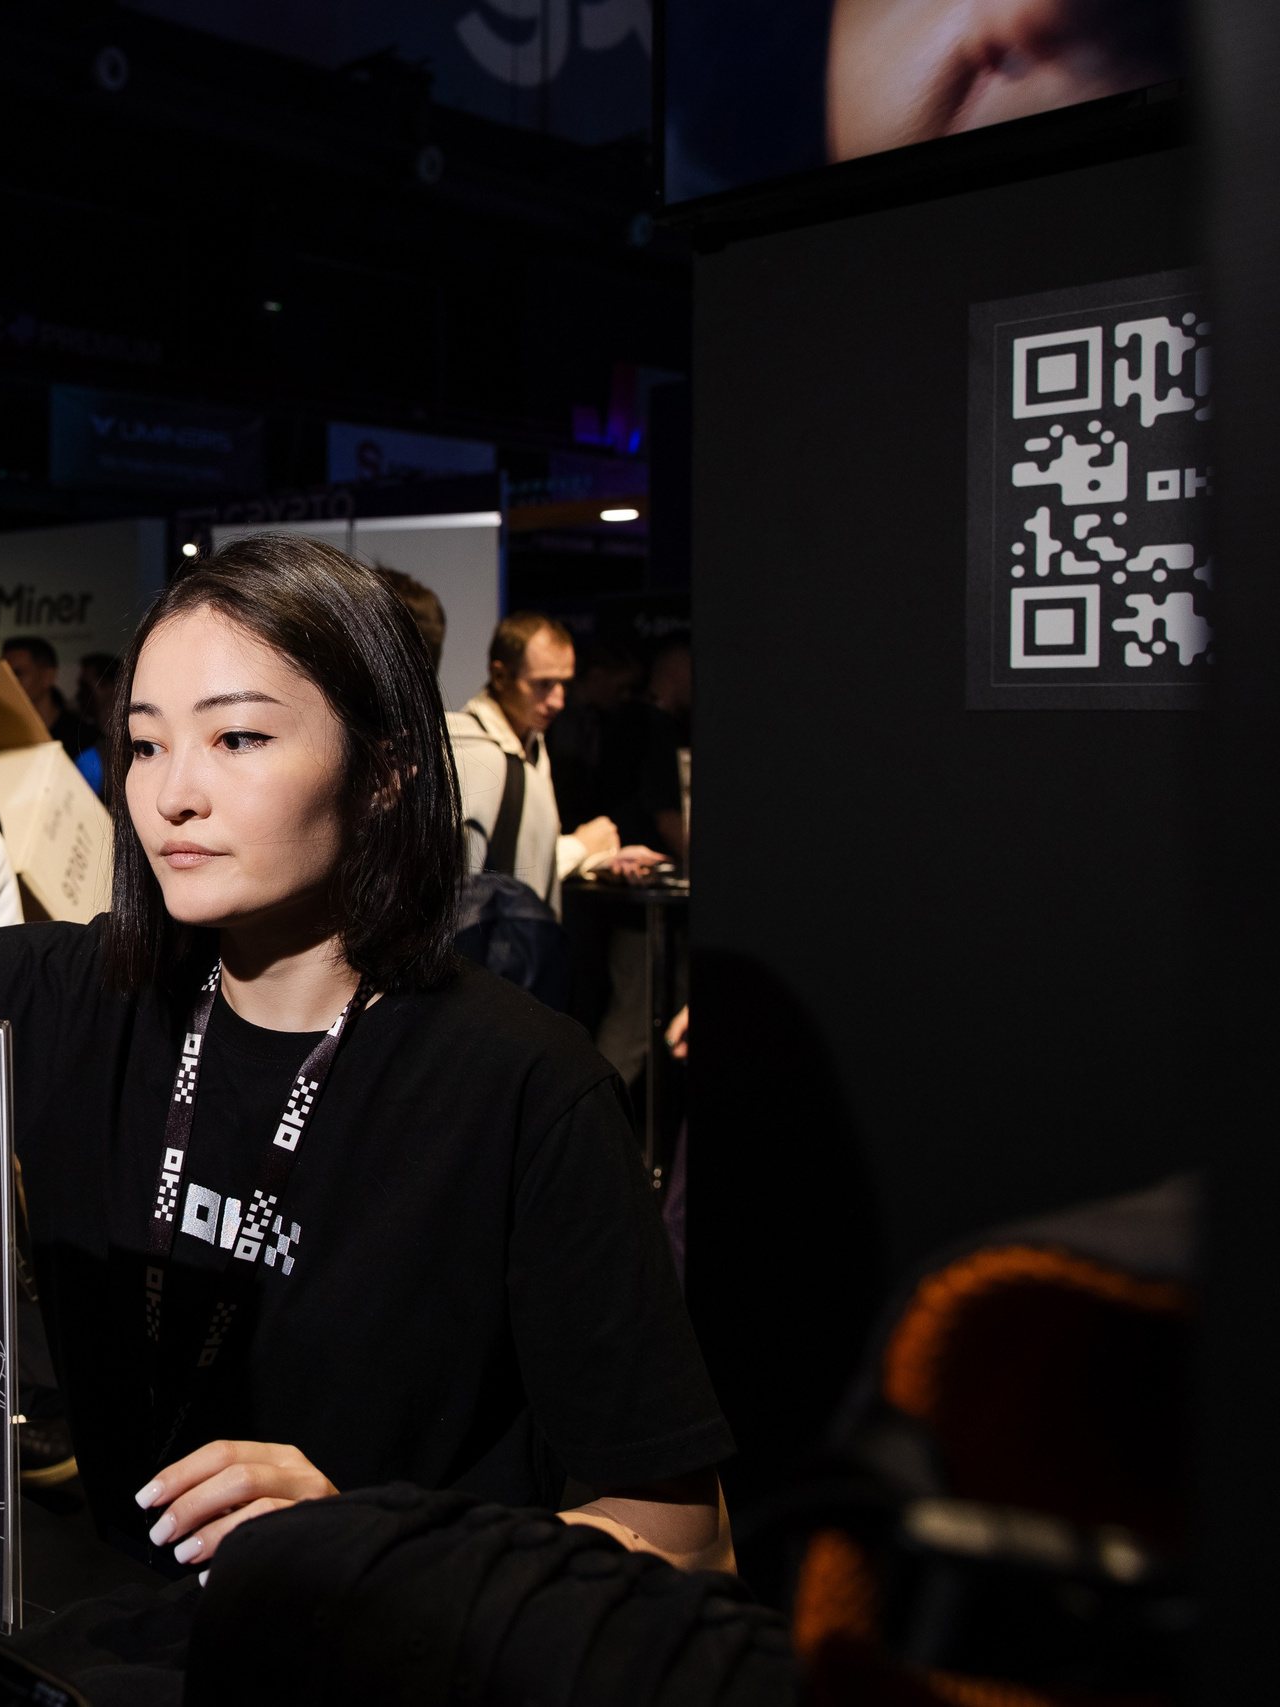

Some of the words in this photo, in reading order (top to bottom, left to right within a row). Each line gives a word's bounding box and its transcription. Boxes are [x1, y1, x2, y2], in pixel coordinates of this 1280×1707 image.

[1146, 465, 1214, 502] OK
[173, 1032, 202, 1105] OKX
[272, 1075, 319, 1152] OKX
[153, 1147, 184, 1222] OKX
[233, 1189, 278, 1263] OKX
